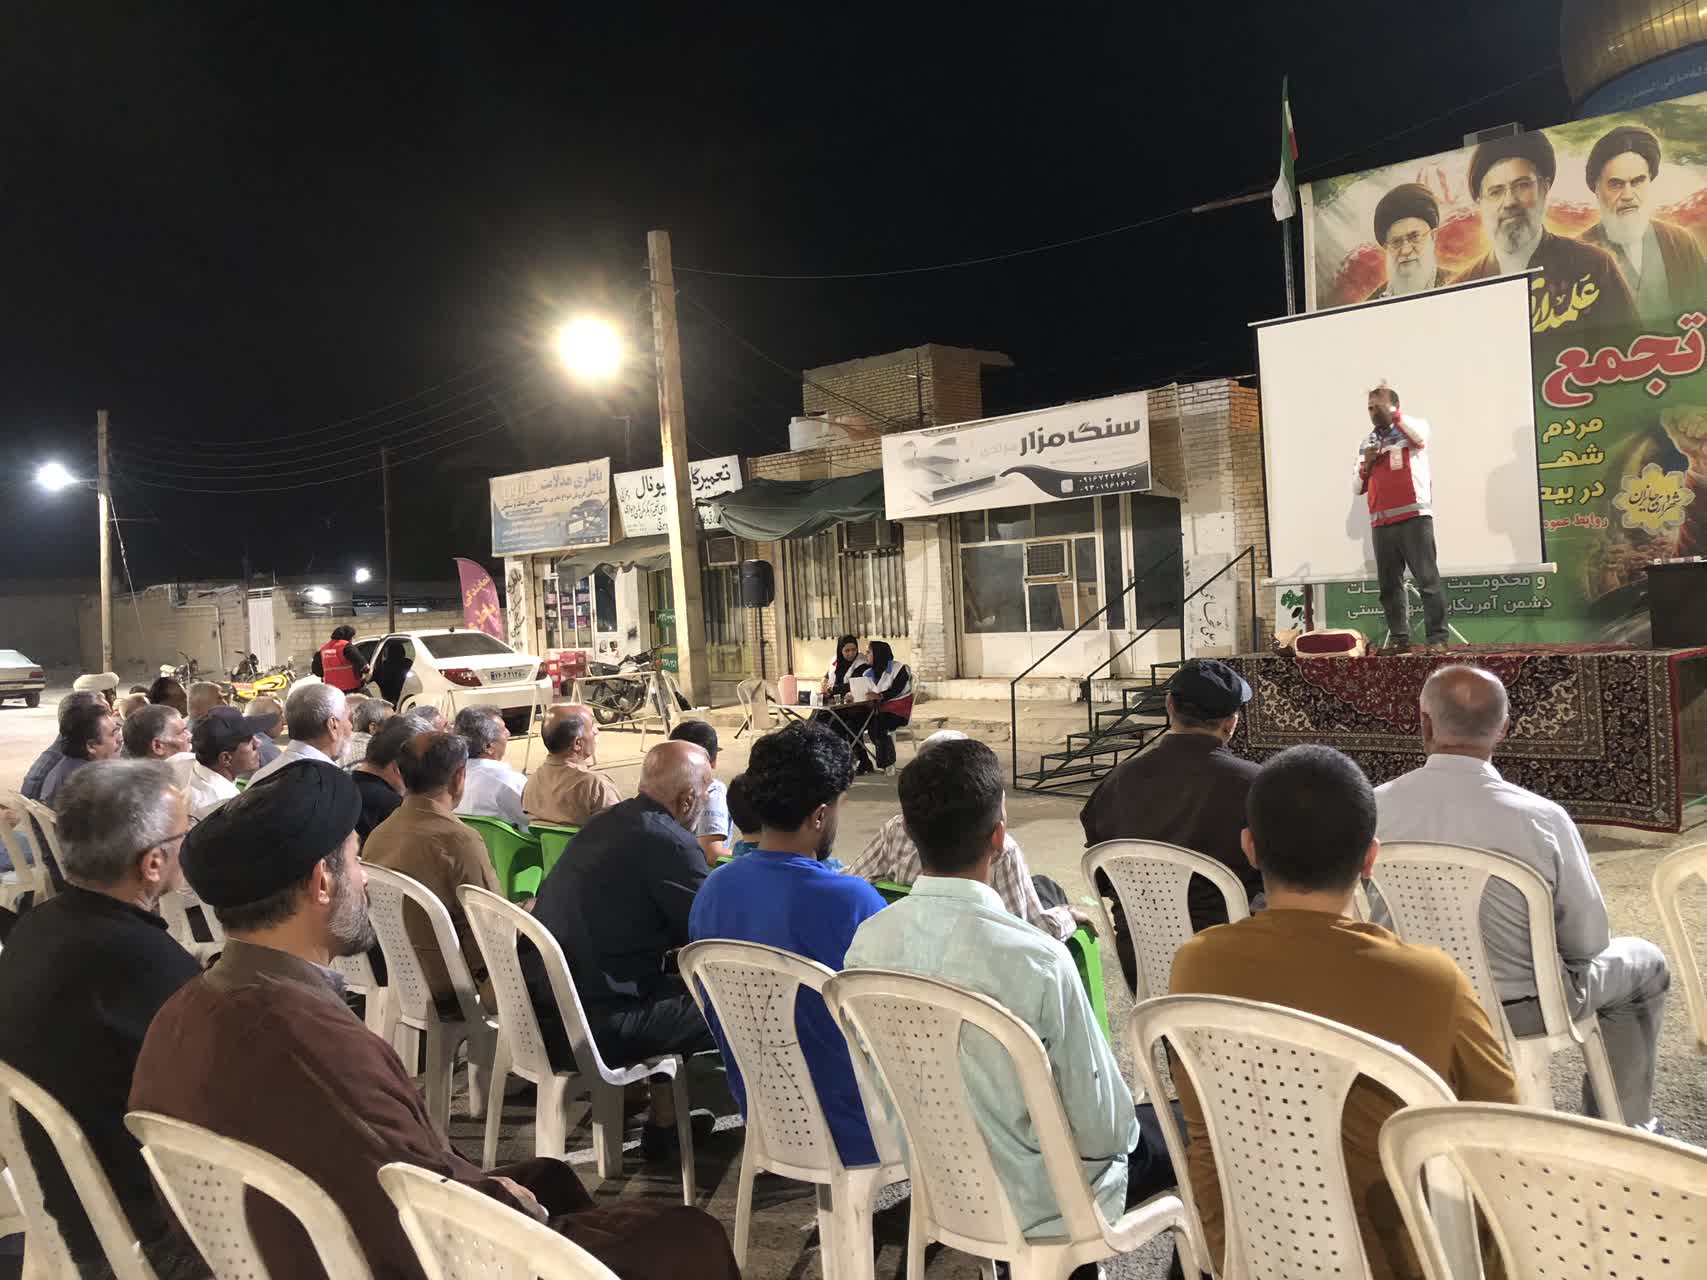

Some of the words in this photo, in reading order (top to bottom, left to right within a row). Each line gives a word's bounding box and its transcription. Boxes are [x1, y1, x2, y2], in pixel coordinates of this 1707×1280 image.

[1542, 312, 1706, 407] تجمع
[1020, 427, 1066, 456] مزار
[1066, 418, 1141, 443] سنگ
[1542, 417, 1604, 444] مردم
[691, 464, 731, 491] تعمیرگا
[1579, 481, 1606, 505] در
[1543, 517, 1570, 532] عمو
[1448, 575, 1530, 591] محکومیت
[1536, 576, 1546, 589] و
[1448, 595, 1498, 614] آمریکای
[1503, 596, 1551, 613] دشمن
